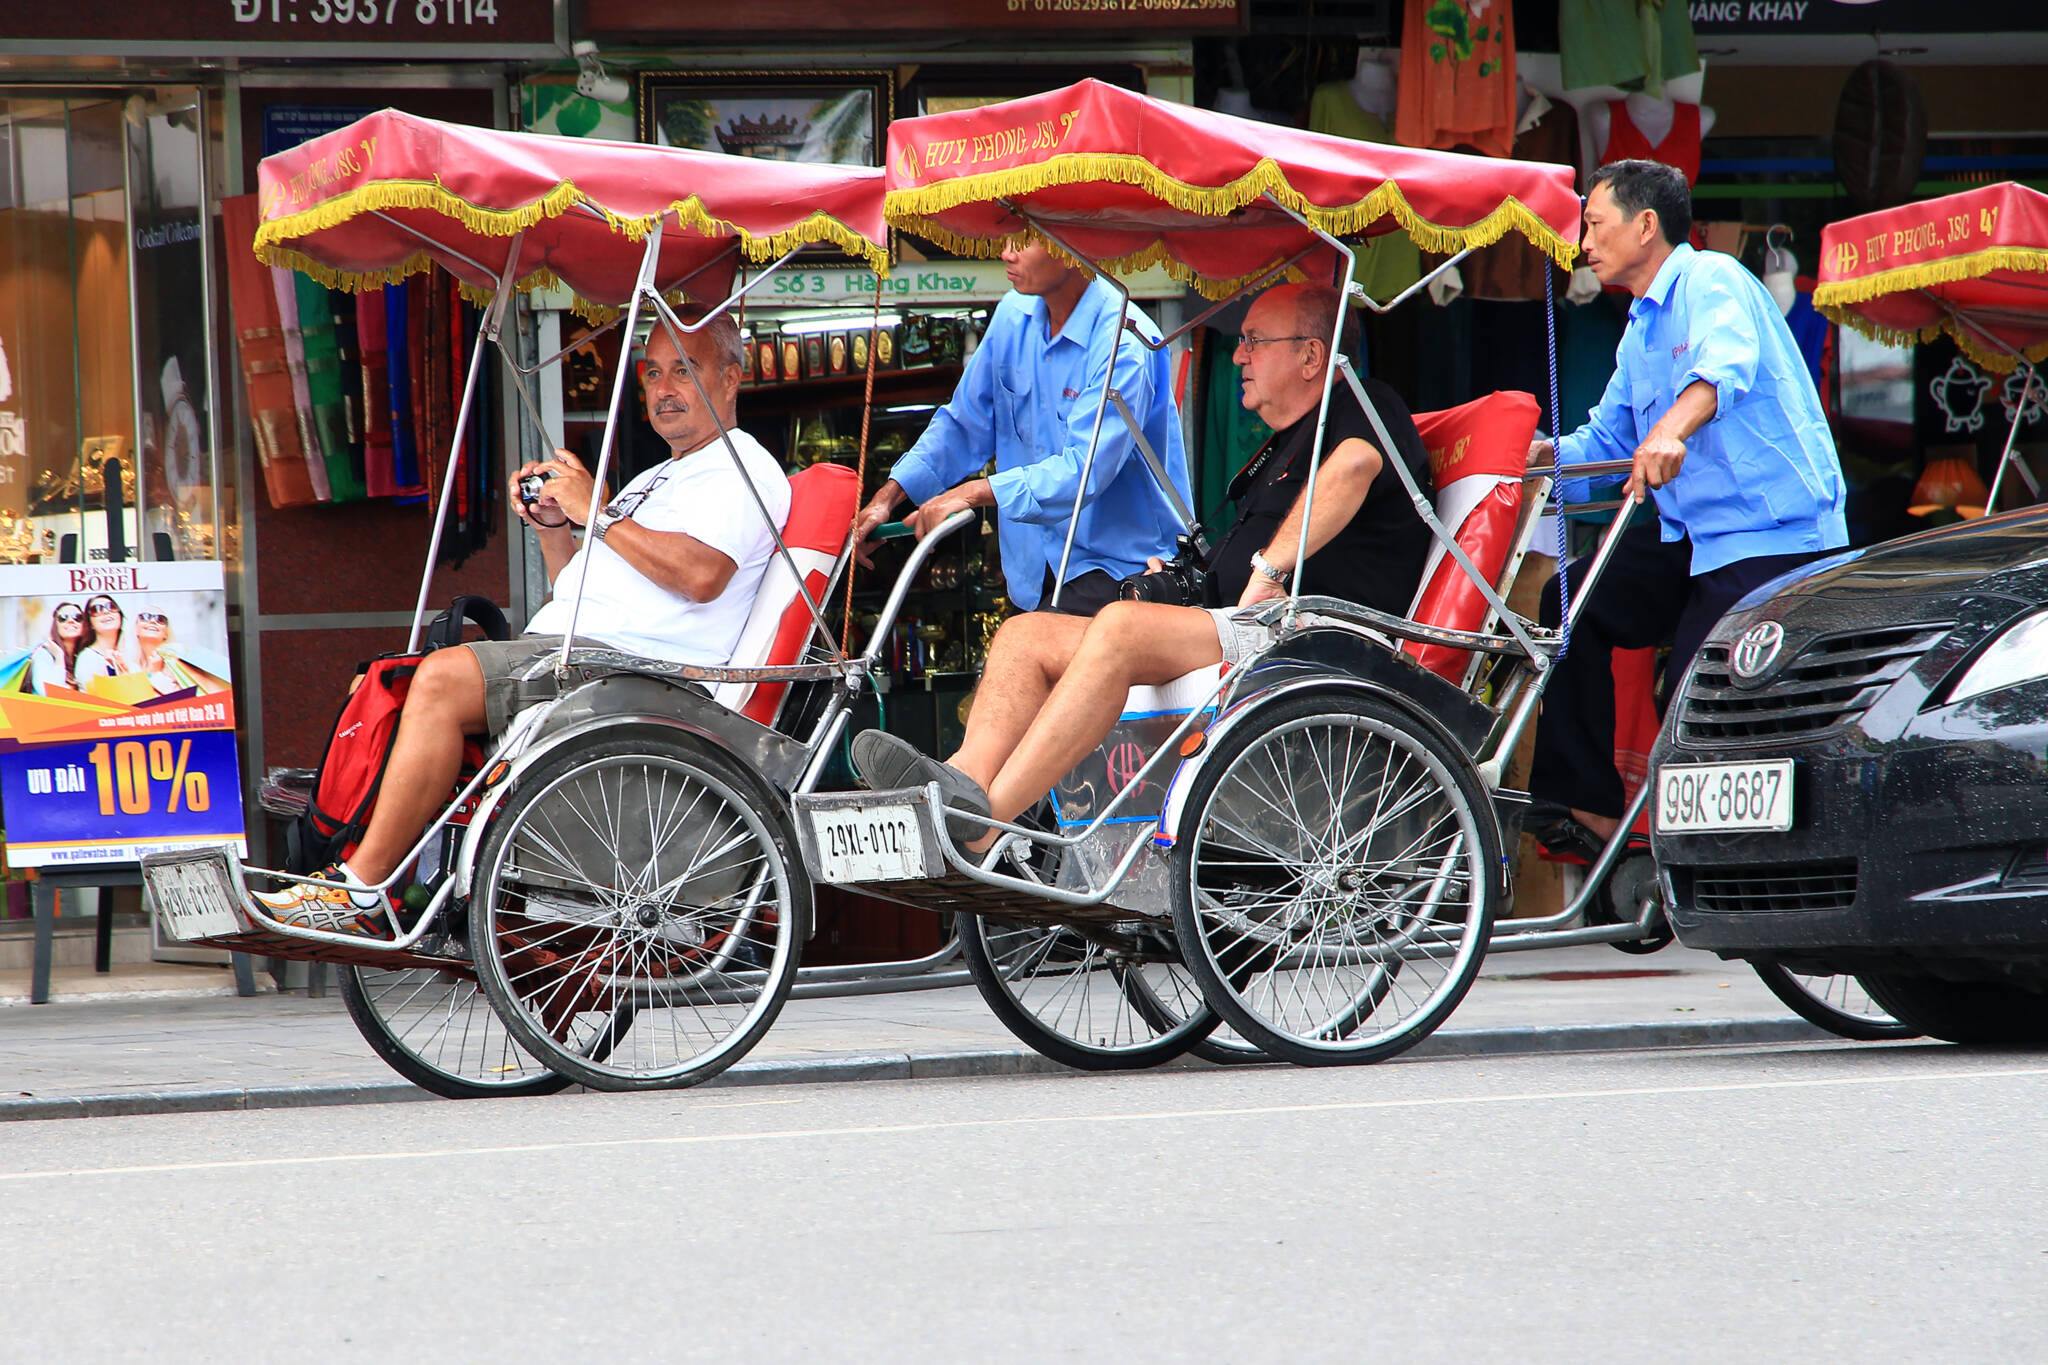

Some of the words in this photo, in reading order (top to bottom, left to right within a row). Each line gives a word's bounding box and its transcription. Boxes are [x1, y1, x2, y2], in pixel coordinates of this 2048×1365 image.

[1748, 2, 1808, 21] KHAY
[924, 138, 968, 169] HUY
[1032, 120, 1060, 150] JSC
[1866, 233, 1888, 264] HUY
[1948, 213, 1970, 243] JSC
[774, 272, 805, 294] Số
[811, 275, 826, 293] 3
[845, 273, 910, 295] Hàng
[917, 272, 977, 293] Khay
[67, 567, 149, 592] BOREL
[85, 566, 130, 576] ERNEST
[55, 763, 87, 793] ĐÃI
[88, 739, 211, 816] 10%
